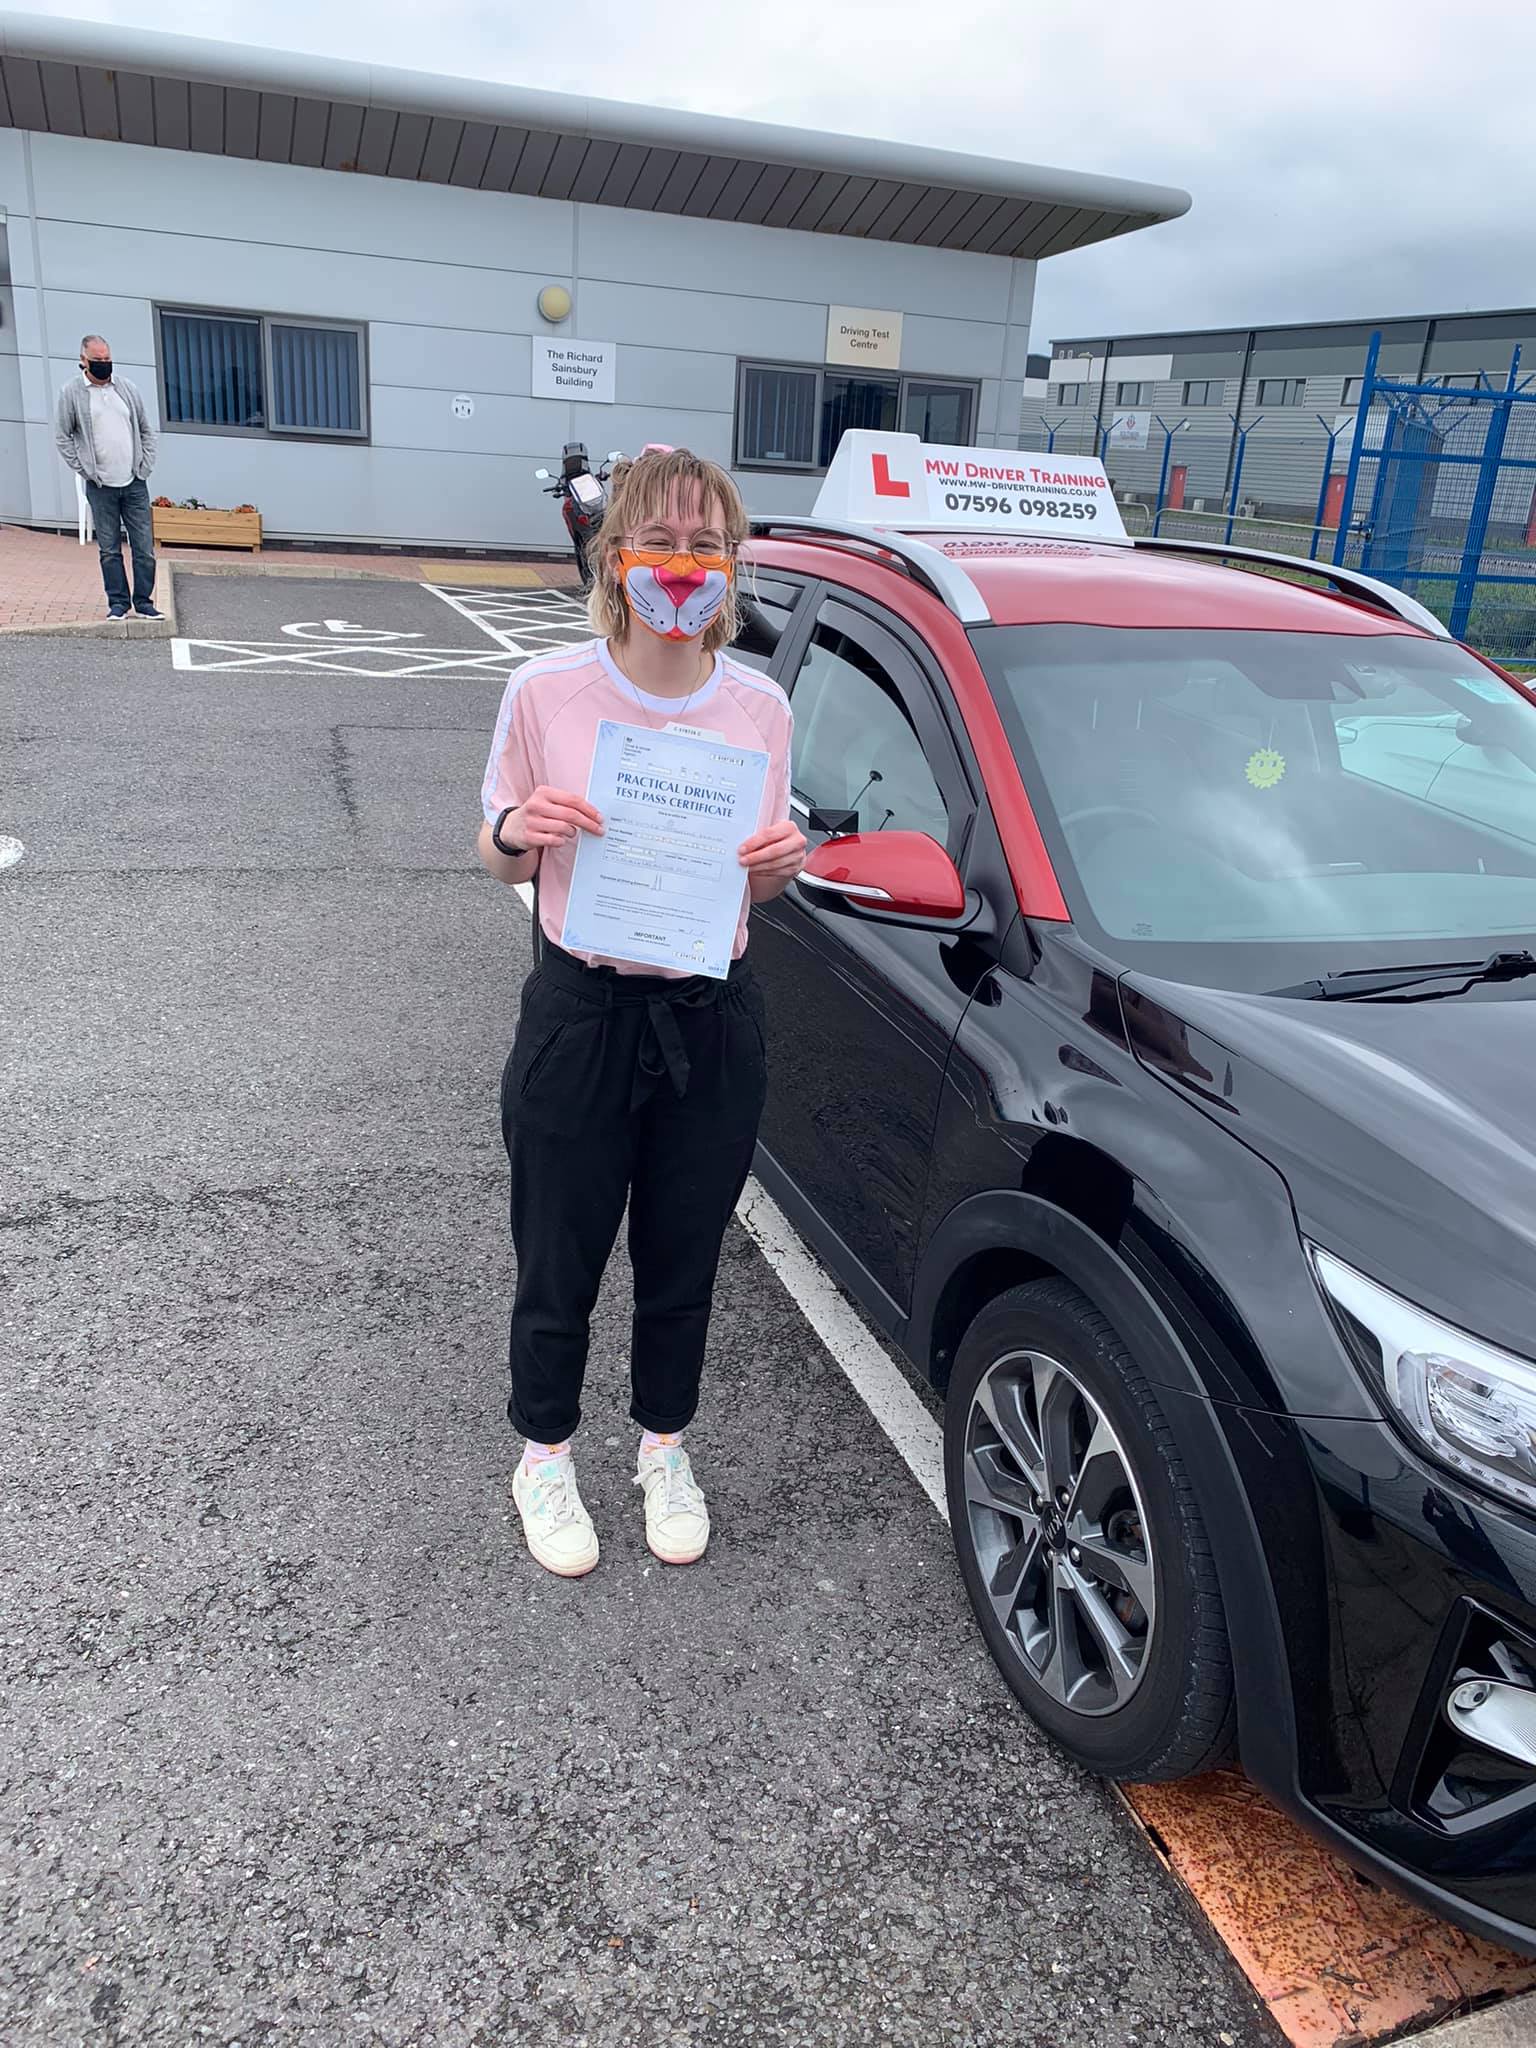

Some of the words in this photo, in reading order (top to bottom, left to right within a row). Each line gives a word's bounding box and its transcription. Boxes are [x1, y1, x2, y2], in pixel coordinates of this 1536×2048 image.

[840, 326, 870, 338] Driving
[872, 329, 890, 338] Test
[850, 339, 878, 350] Centre
[547, 350, 564, 360] The
[567, 351, 603, 363] Richard
[551, 362, 598, 376] Sainsbury
[555, 376, 593, 389] Building
[871, 453, 910, 498] L
[925, 459, 959, 476] MW
[965, 463, 1025, 483] DRIVER
[1029, 468, 1106, 488] TRAINING
[939, 477, 1098, 497] WWW.MW-DRIVERTRAINING.CO.UK
[945, 493, 1012, 514] 07596
[1019, 501, 1098, 520] 098259
[617, 772, 680, 794] PRACTICAL
[684, 784, 736, 805] DRIVING
[615, 786, 639, 800] TEST
[641, 792, 667, 805] PASS
[669, 797, 734, 818] CERTIFICATE
[634, 931, 667, 942] IMPORTANT
